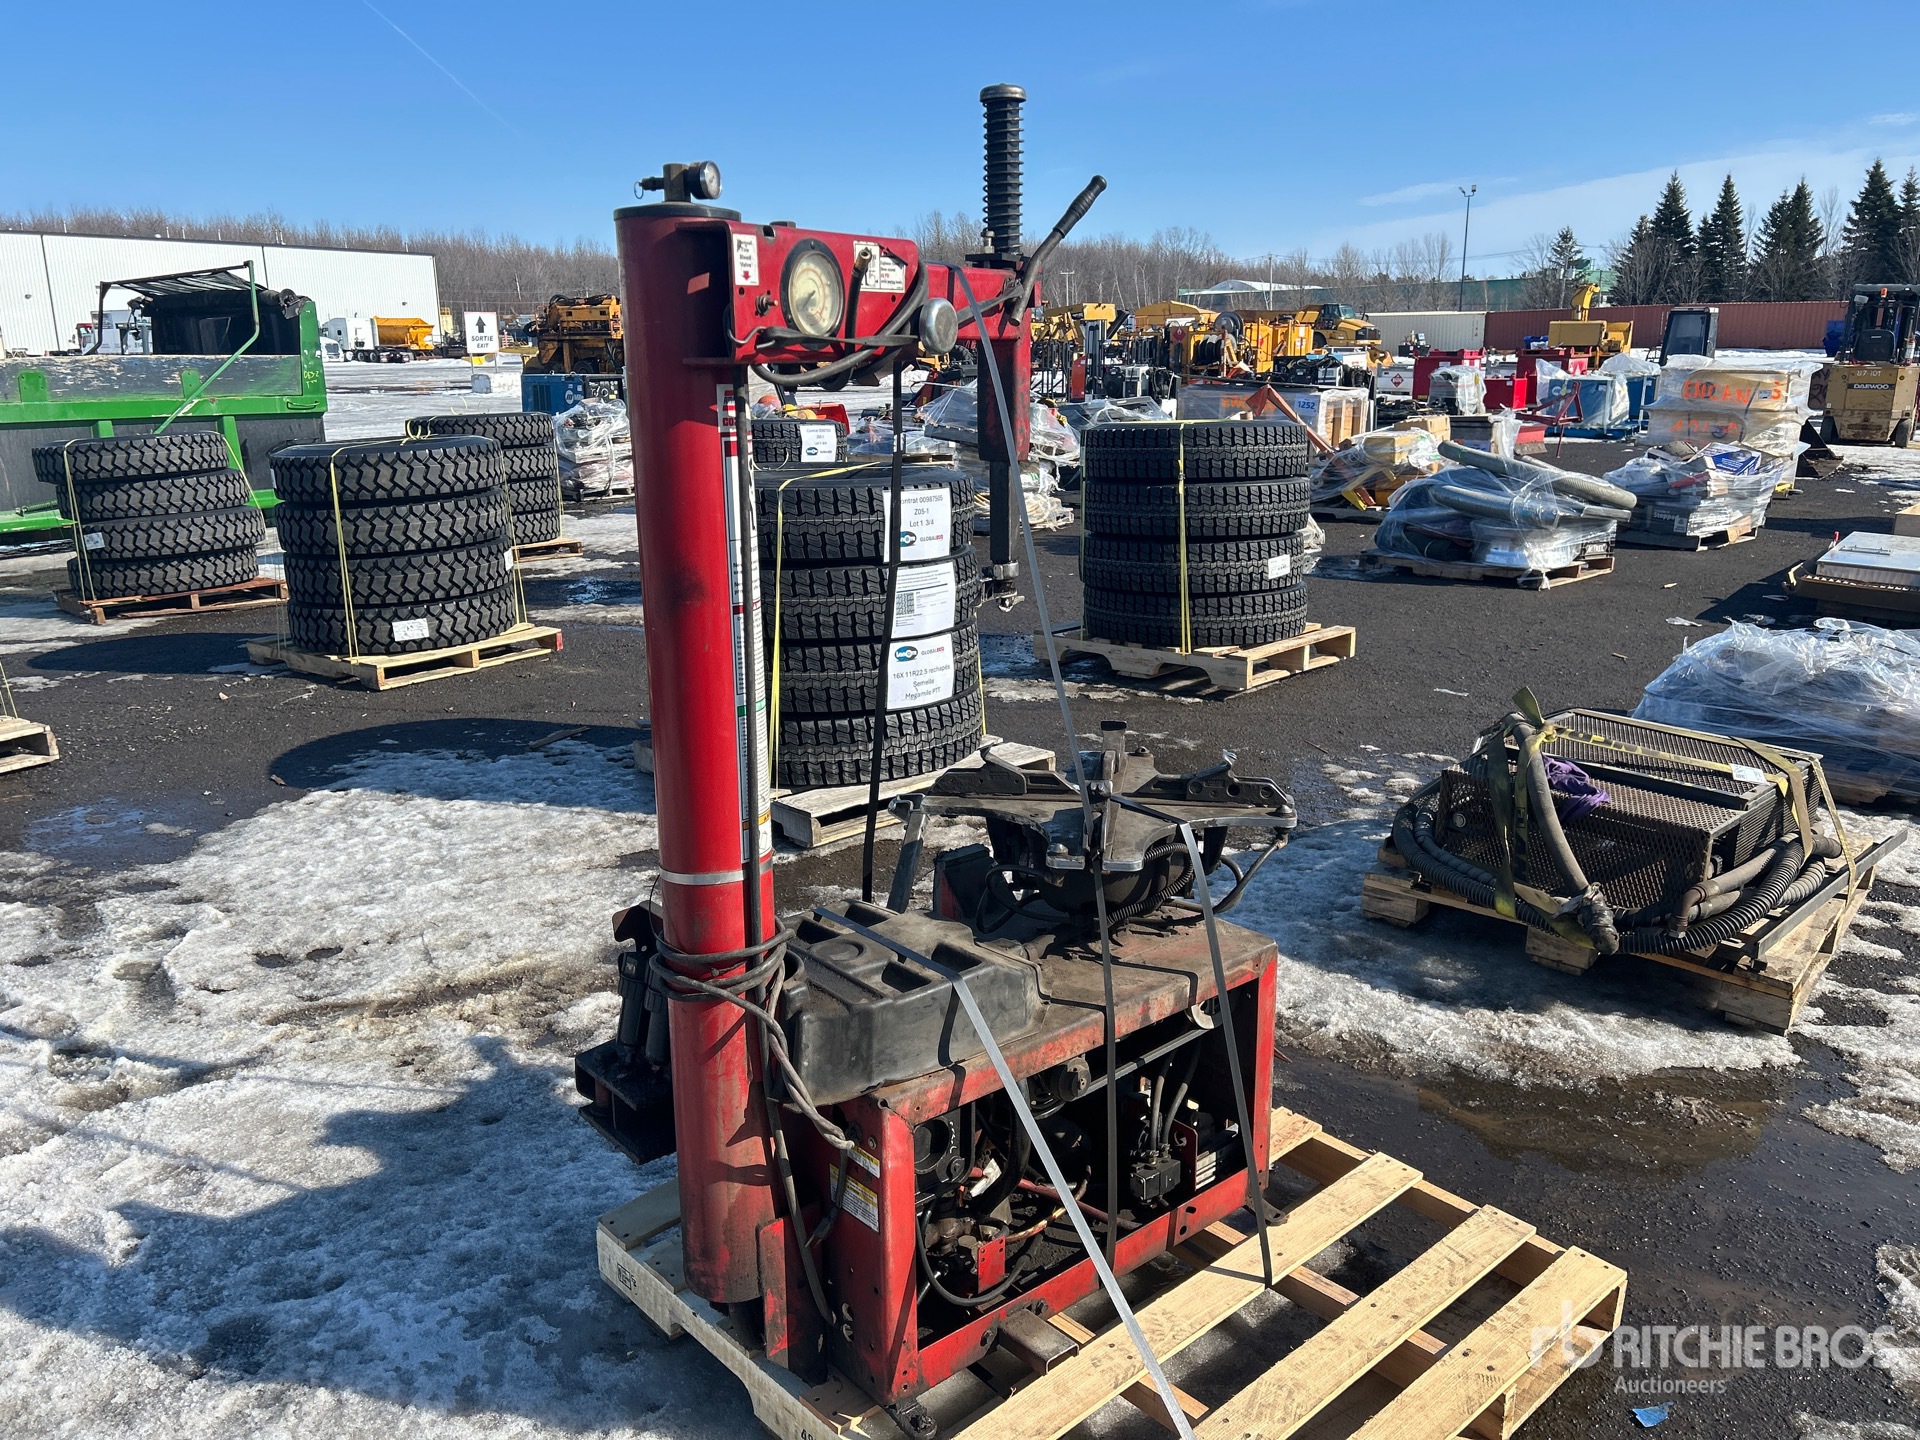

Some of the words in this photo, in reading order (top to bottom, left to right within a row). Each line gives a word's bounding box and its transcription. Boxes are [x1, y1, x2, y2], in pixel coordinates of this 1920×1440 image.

[1297, 401, 1315, 409] 1252
[914, 508, 929, 516] Z05-1
[905, 668, 928, 678] 11R22.5
[913, 678, 935, 688] Semelle
[905, 690, 932, 700] Megamile
[932, 686, 941, 694] PTT
